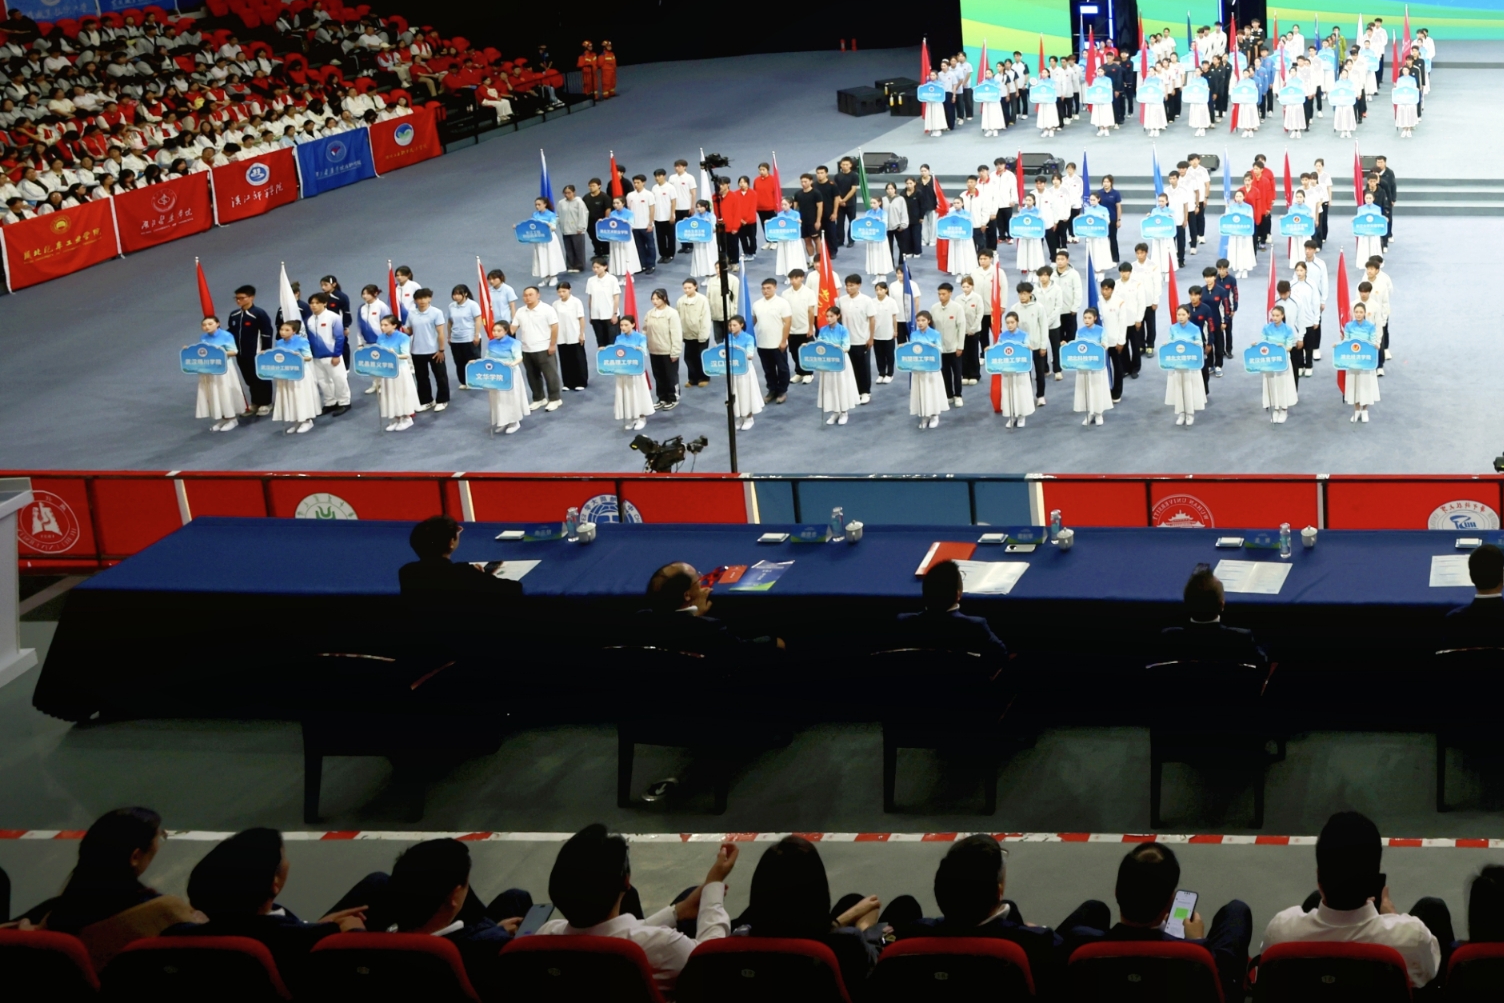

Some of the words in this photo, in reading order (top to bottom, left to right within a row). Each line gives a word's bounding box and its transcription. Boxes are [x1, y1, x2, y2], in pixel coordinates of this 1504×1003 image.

[710, 359, 740, 367] 汉口院
[475, 373, 504, 382] 文华学院
